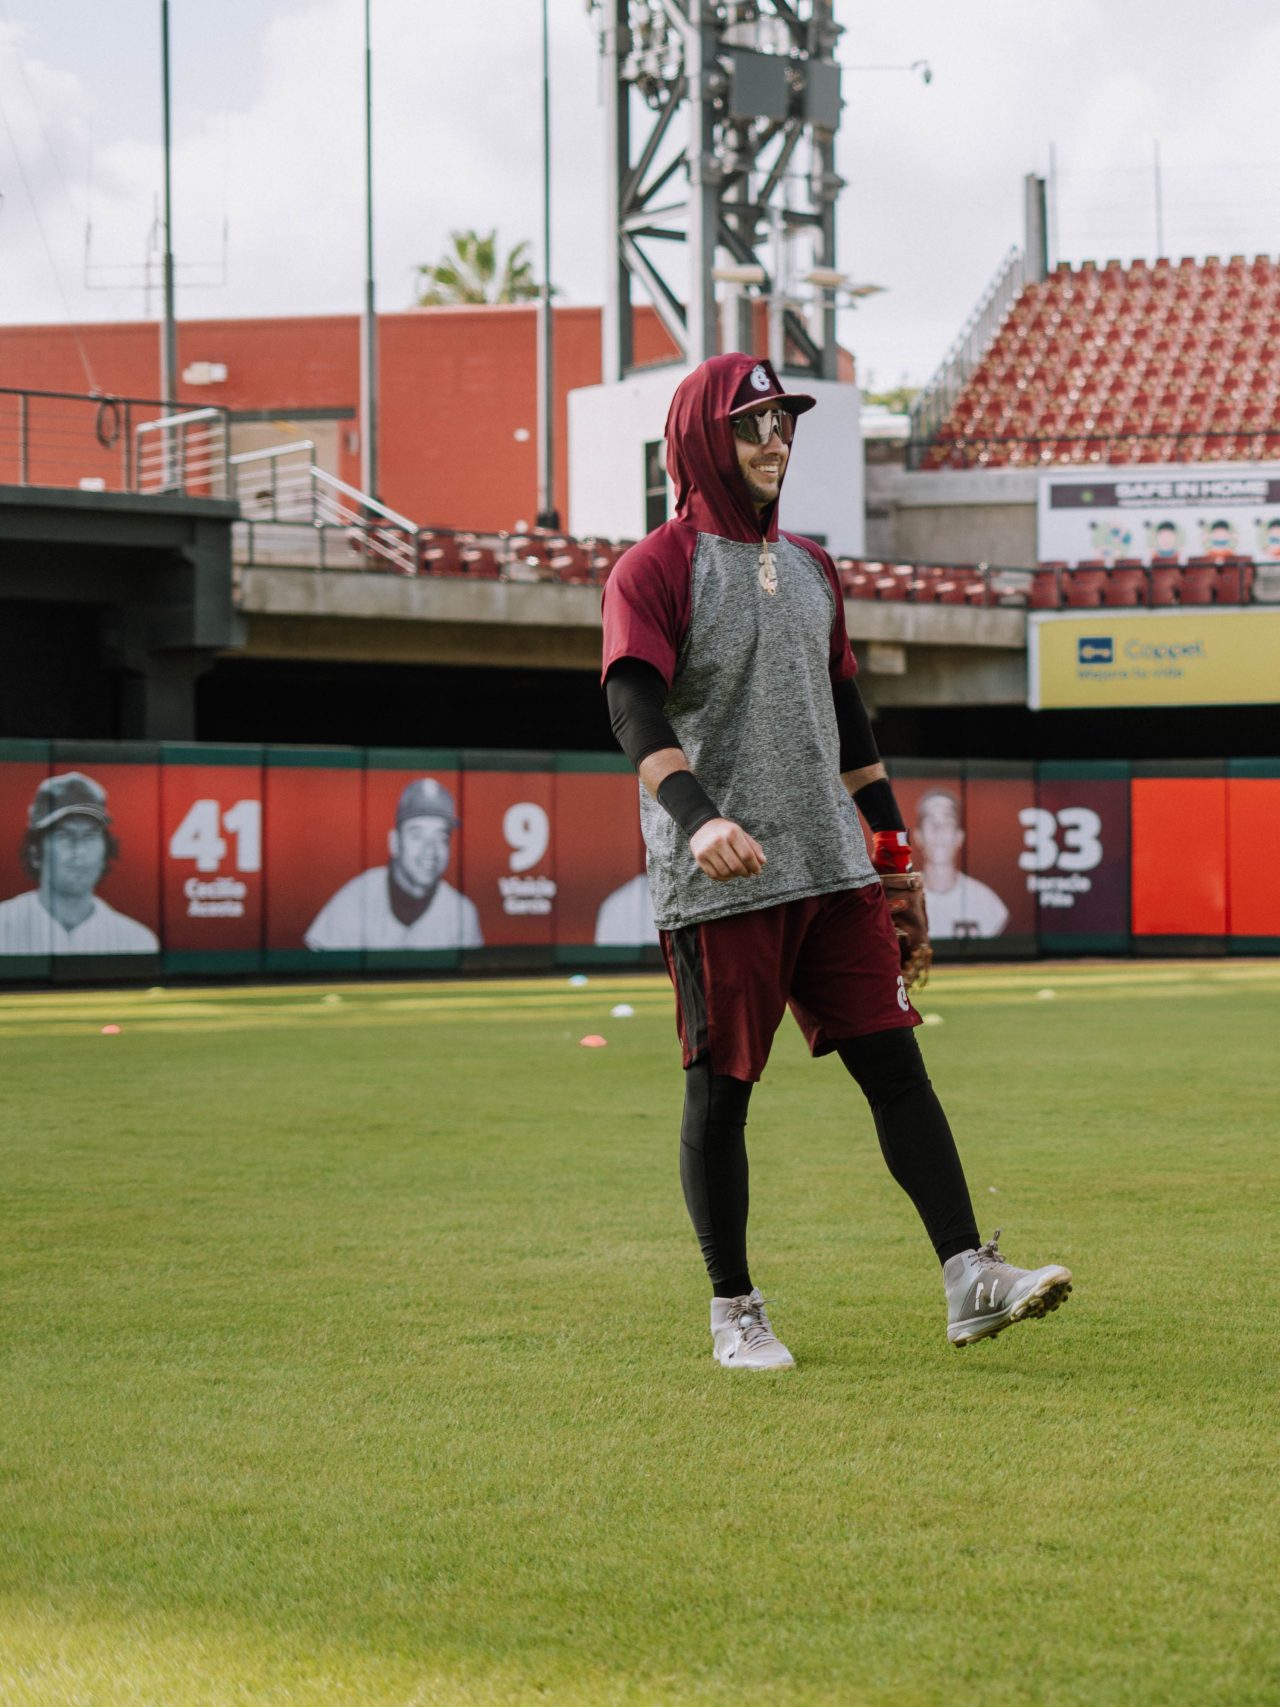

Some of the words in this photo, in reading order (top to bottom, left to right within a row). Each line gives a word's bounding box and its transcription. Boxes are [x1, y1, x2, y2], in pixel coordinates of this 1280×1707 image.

[169, 799, 261, 872] 41
[503, 801, 550, 873] 9
[1018, 807, 1103, 872] 33
